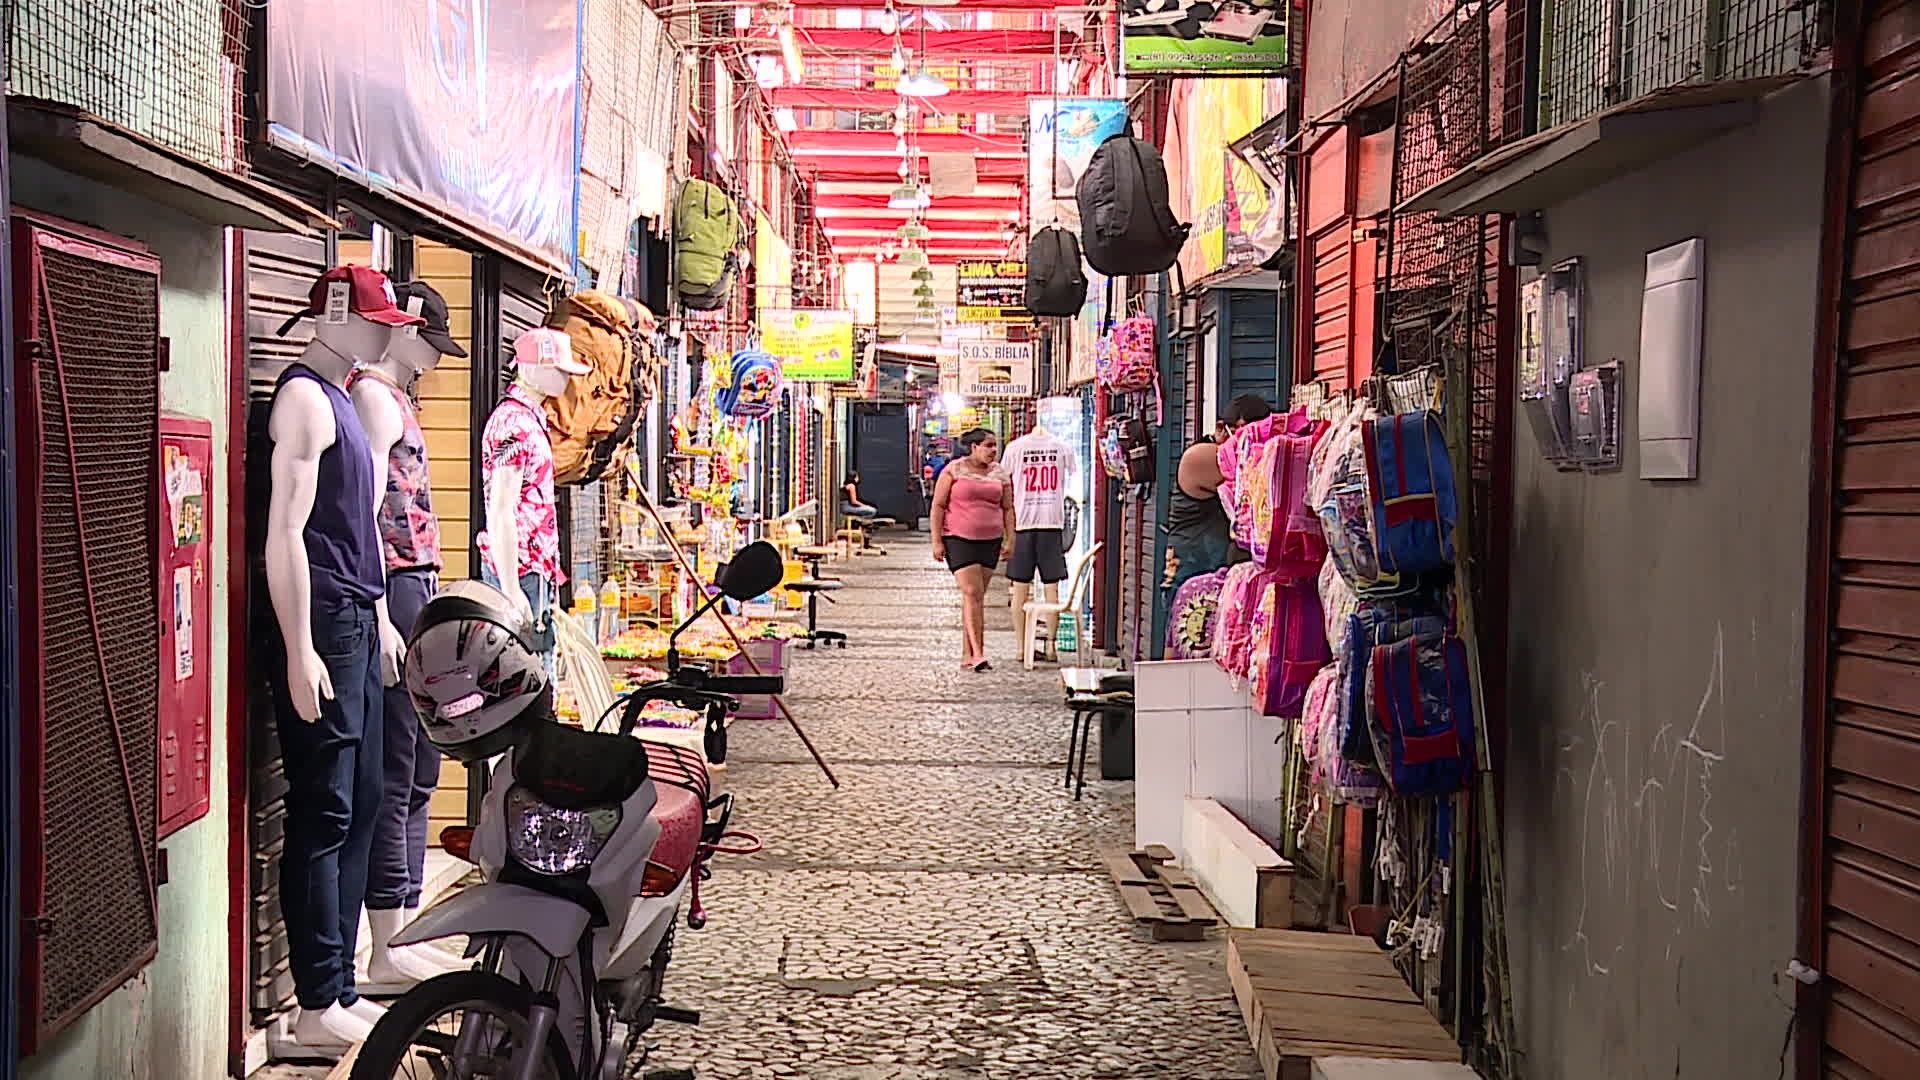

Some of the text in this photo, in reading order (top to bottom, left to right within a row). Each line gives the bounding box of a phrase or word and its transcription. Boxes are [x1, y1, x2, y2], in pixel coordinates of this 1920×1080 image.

[960, 262, 994, 277] LIMA
[962, 344, 1029, 359] S.O.S. BÍBLIA
[1023, 455, 1056, 463] FOTO
[1023, 466, 1058, 494] 12,00
